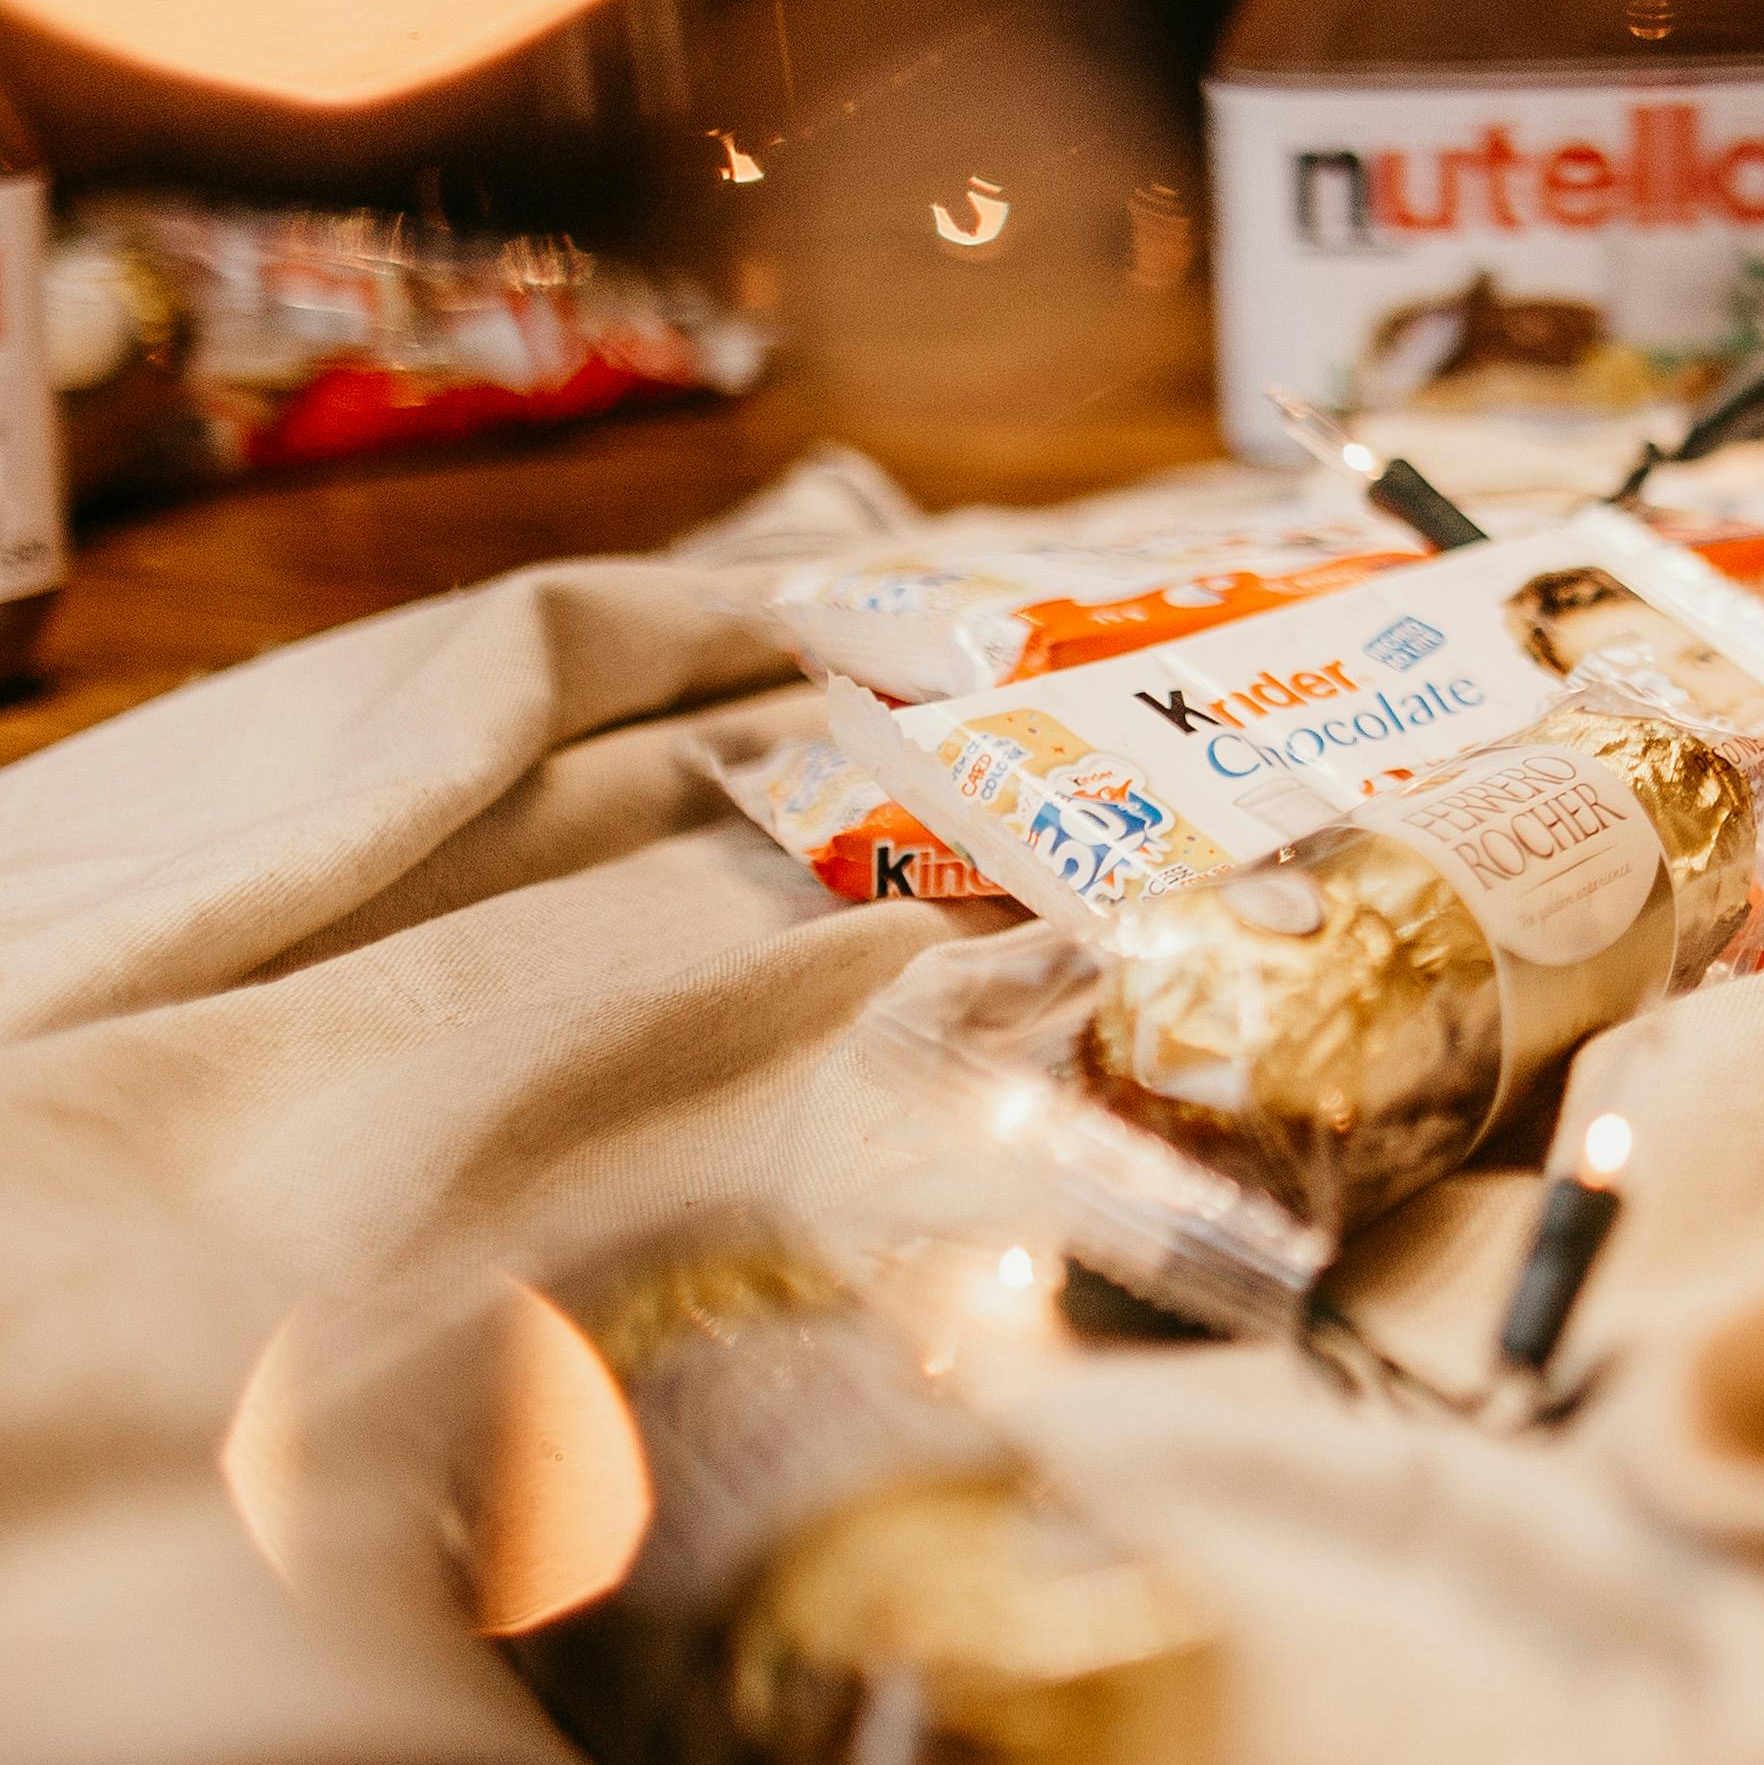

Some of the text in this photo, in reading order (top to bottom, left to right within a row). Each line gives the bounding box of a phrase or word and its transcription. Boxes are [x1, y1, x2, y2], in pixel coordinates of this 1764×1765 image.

[1133, 659, 1361, 736] Knder
[1206, 678, 1485, 779] Chocolate
[1400, 755, 1577, 842] FERRERO
[1452, 782, 1629, 892] ROCHER
[874, 841, 1009, 899] Kin
